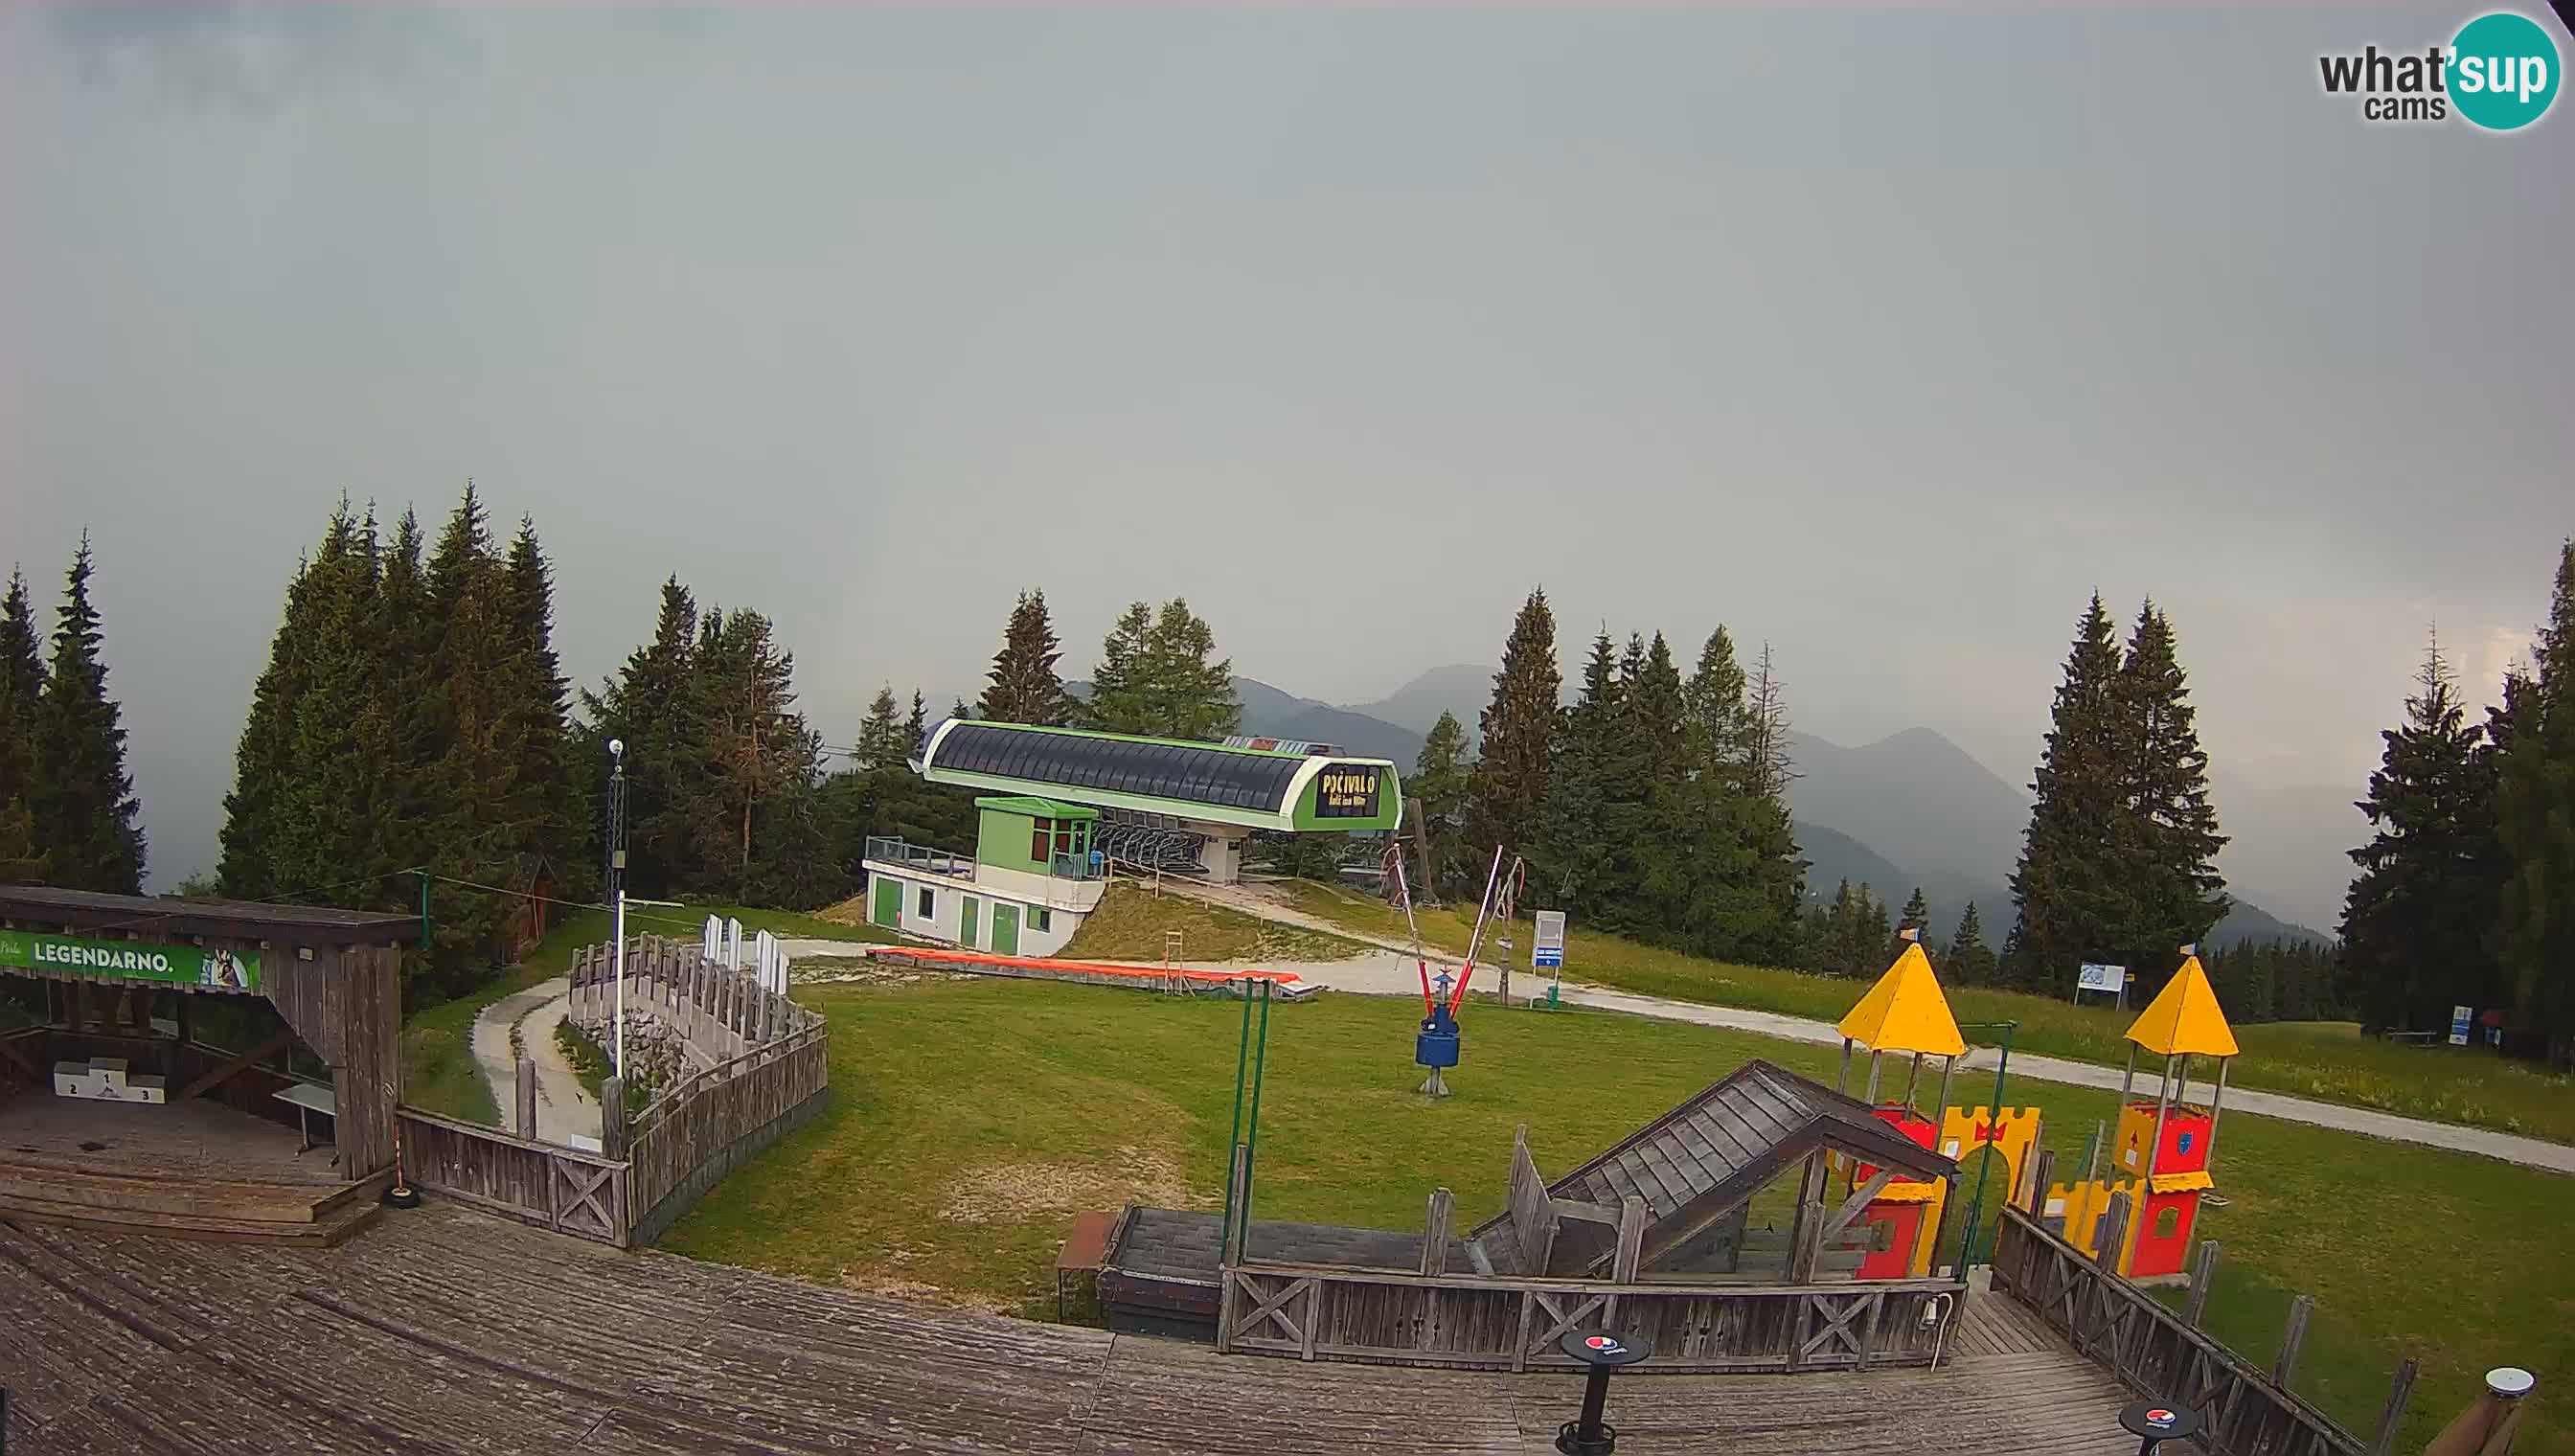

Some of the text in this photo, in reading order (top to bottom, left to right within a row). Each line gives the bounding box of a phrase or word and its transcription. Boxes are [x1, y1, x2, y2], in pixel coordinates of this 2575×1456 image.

[34, 943, 174, 973] LEGENDARNO.
[104, 1073, 110, 1083] 1
[70, 1083, 78, 1094] 2
[142, 1090, 149, 1100] 3
